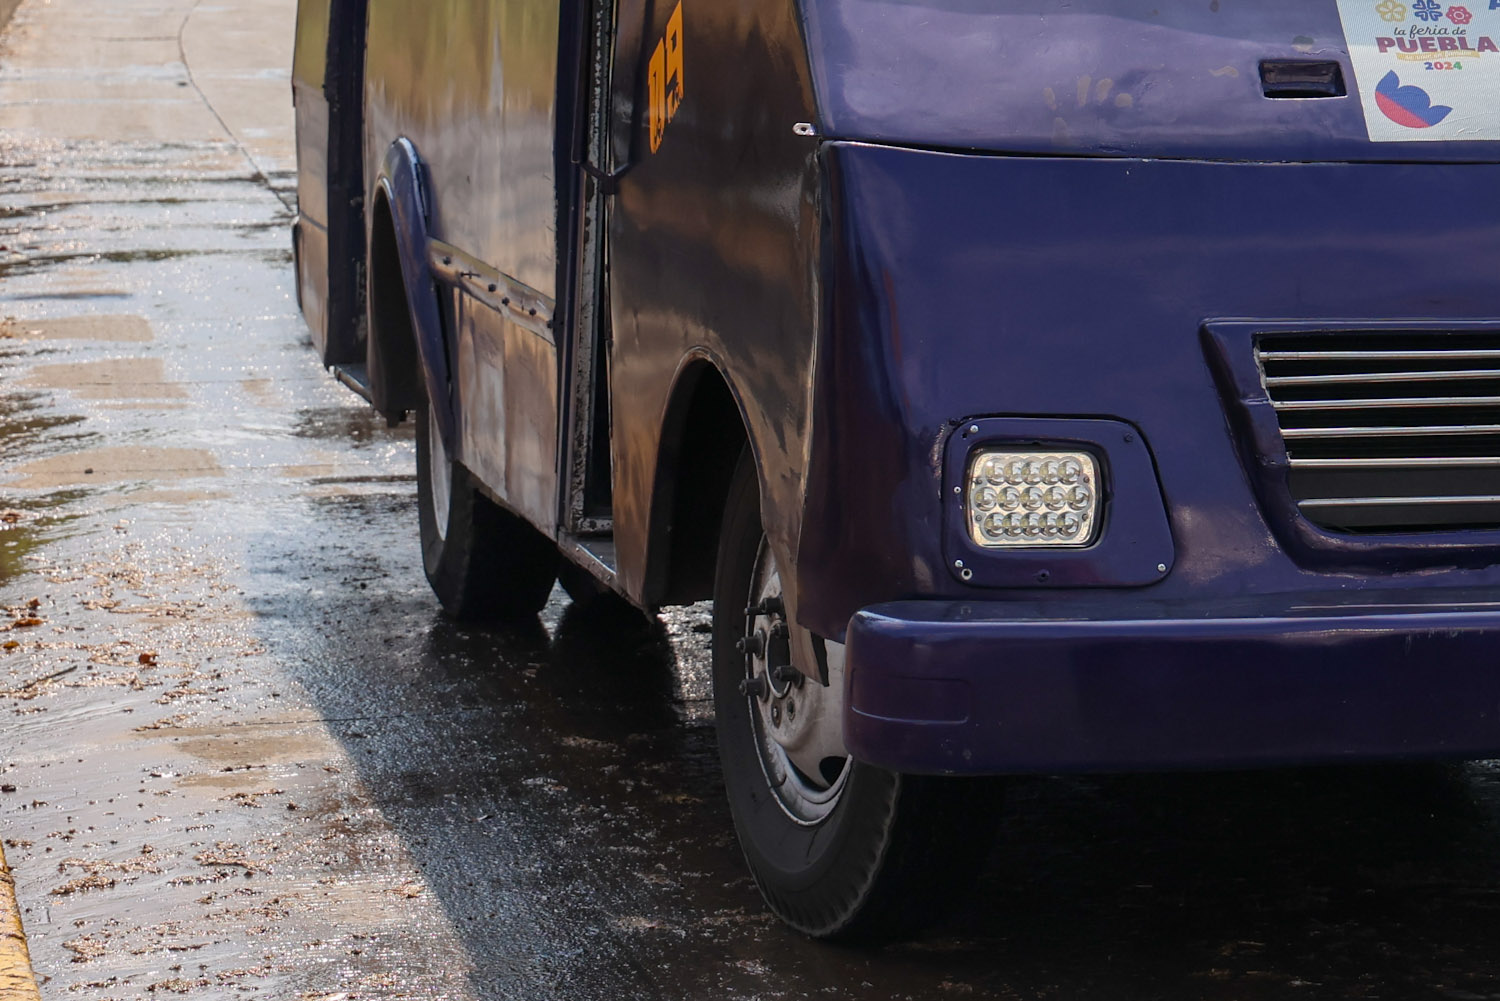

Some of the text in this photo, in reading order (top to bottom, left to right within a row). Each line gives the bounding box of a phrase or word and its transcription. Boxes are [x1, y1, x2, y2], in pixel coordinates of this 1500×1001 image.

[1393, 24, 1467, 39] la feria de
[1375, 36, 1500, 54] PUEBLA
[1424, 61, 1463, 71] 2024
